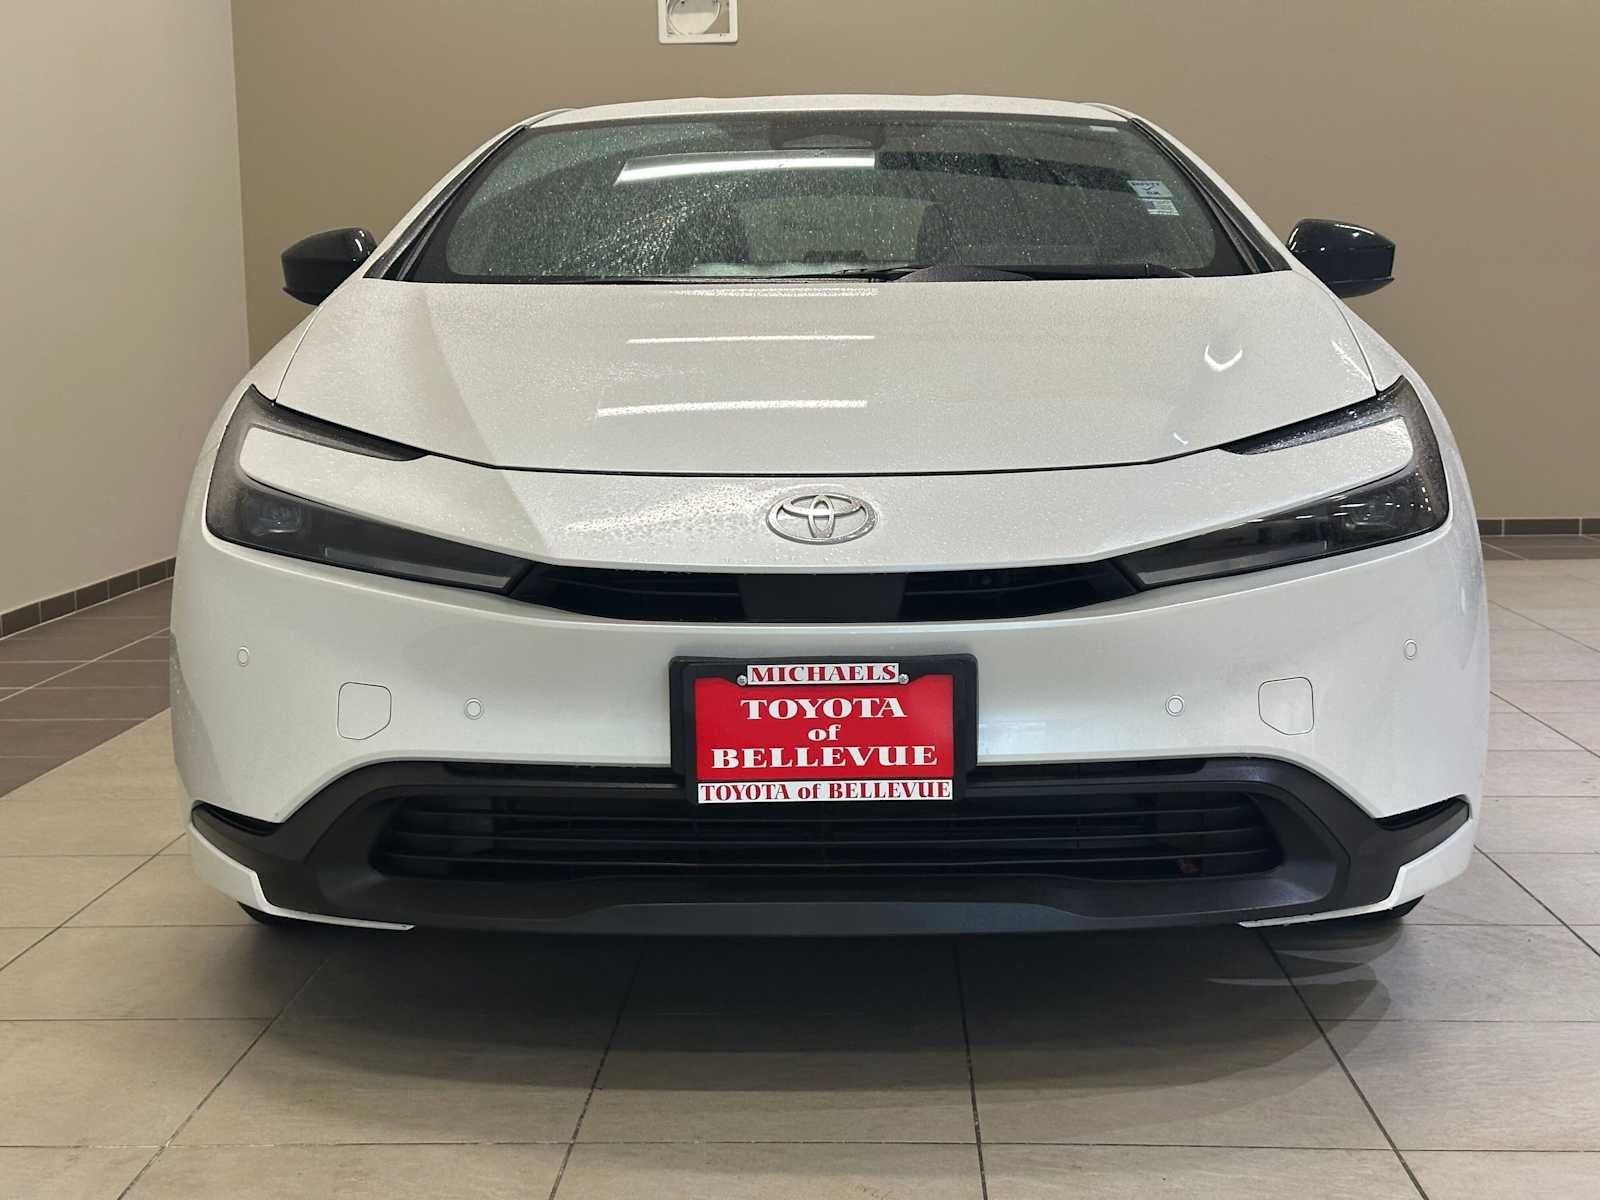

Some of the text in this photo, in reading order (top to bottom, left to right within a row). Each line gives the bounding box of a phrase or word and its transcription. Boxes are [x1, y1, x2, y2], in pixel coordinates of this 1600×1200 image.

[752, 665, 896, 682] MICHAELS
[741, 697, 907, 720] TOYOTA
[808, 724, 841, 741] of
[712, 745, 938, 769] BELLEVUE
[701, 782, 950, 800] TOYOTA of BELLEVUE
